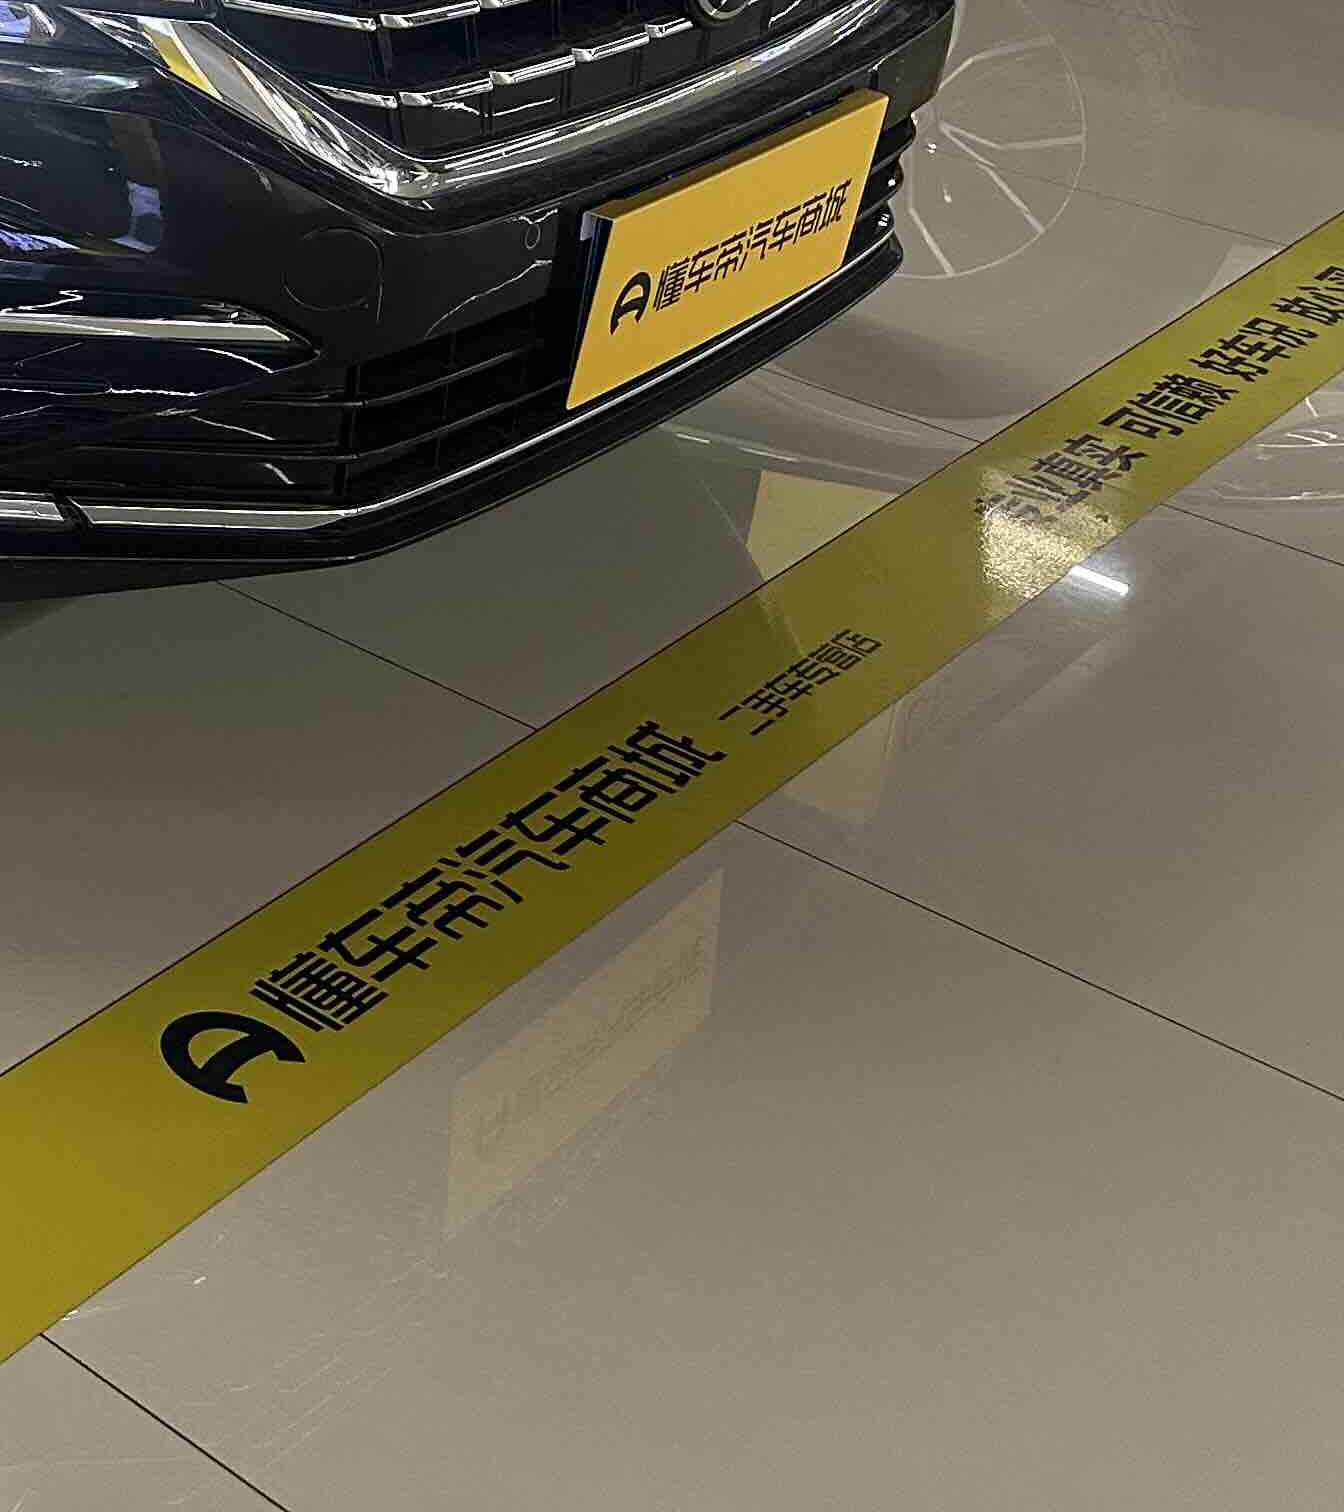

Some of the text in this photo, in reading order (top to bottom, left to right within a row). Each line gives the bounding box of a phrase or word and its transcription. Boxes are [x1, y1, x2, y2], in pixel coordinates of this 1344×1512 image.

[653, 179, 852, 312] 懂车帝汽车商城
[1098, 373, 1240, 439] 可信赖
[1189, 317, 1319, 383] 好车况
[248, 629, 882, 1032] 懂车帝汽车商城 二手车专营店
